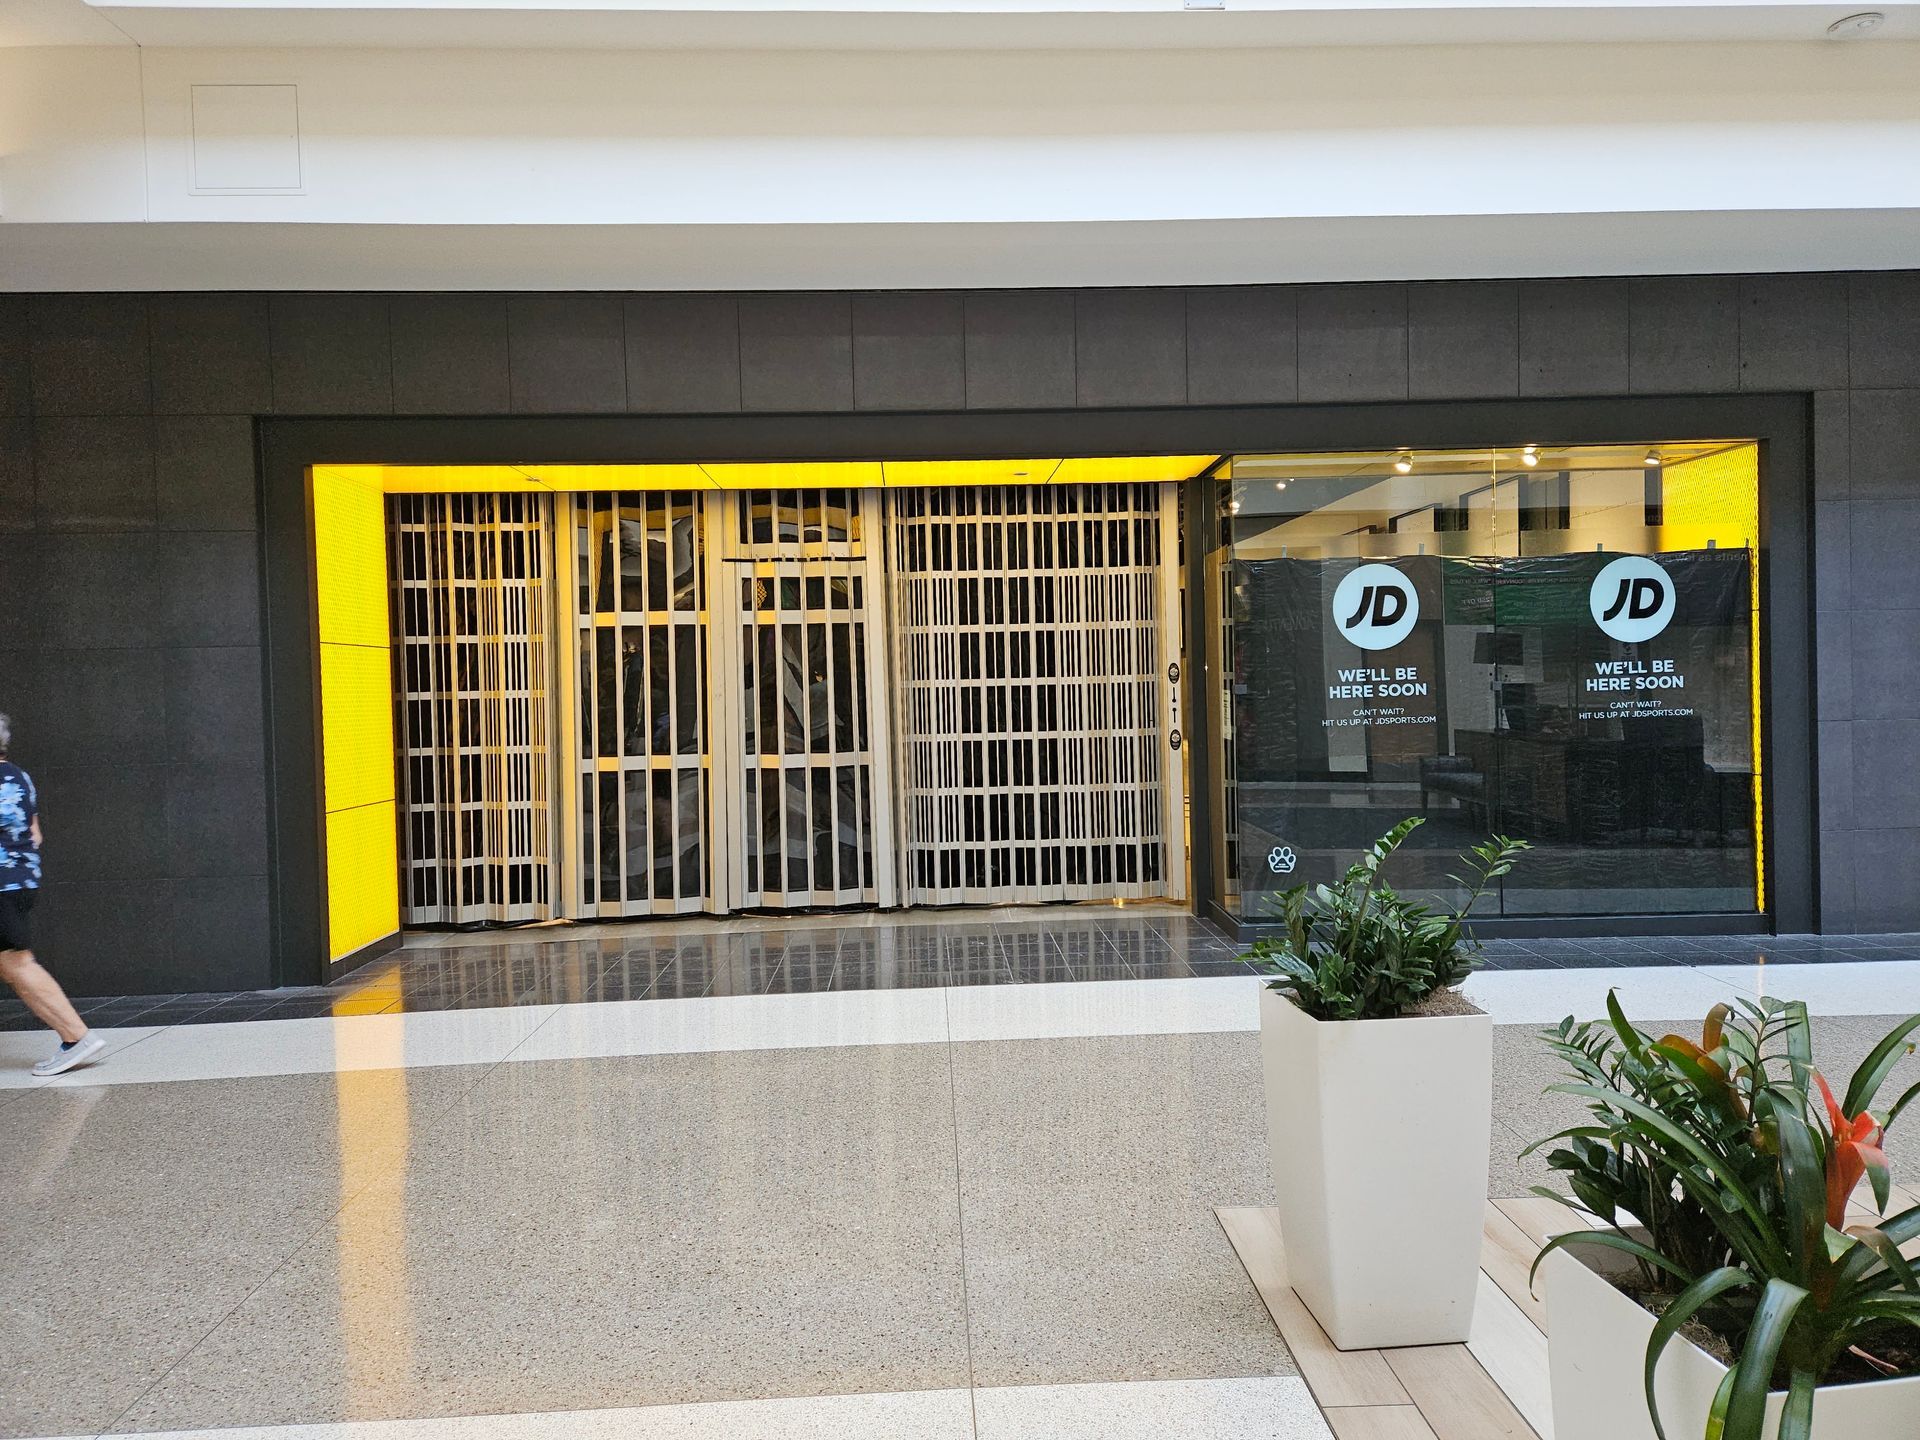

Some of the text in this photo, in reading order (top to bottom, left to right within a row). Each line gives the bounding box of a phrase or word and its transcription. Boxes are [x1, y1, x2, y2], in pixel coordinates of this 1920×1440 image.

[1346, 585, 1408, 629] JD
[1603, 577, 1665, 622] JD
[1338, 667, 1417, 682] WE'LL BE
[1595, 659, 1675, 675] WE'LL BE
[1329, 682, 1427, 699] HERE SOON
[1586, 675, 1684, 691] HERE SOON
[1353, 707, 1405, 716] CAN'T WAIT?
[1610, 700, 1662, 709] CAN'T WAIT?
[1593, 711, 1605, 719] US
[1619, 710, 1630, 718] AT
[1632, 708, 1694, 718] JDSPORTS.COM
[1321, 719, 1335, 727] HIT
[1349, 718, 1361, 726] UP
[1375, 716, 1437, 725] JDSPORTS.COM
